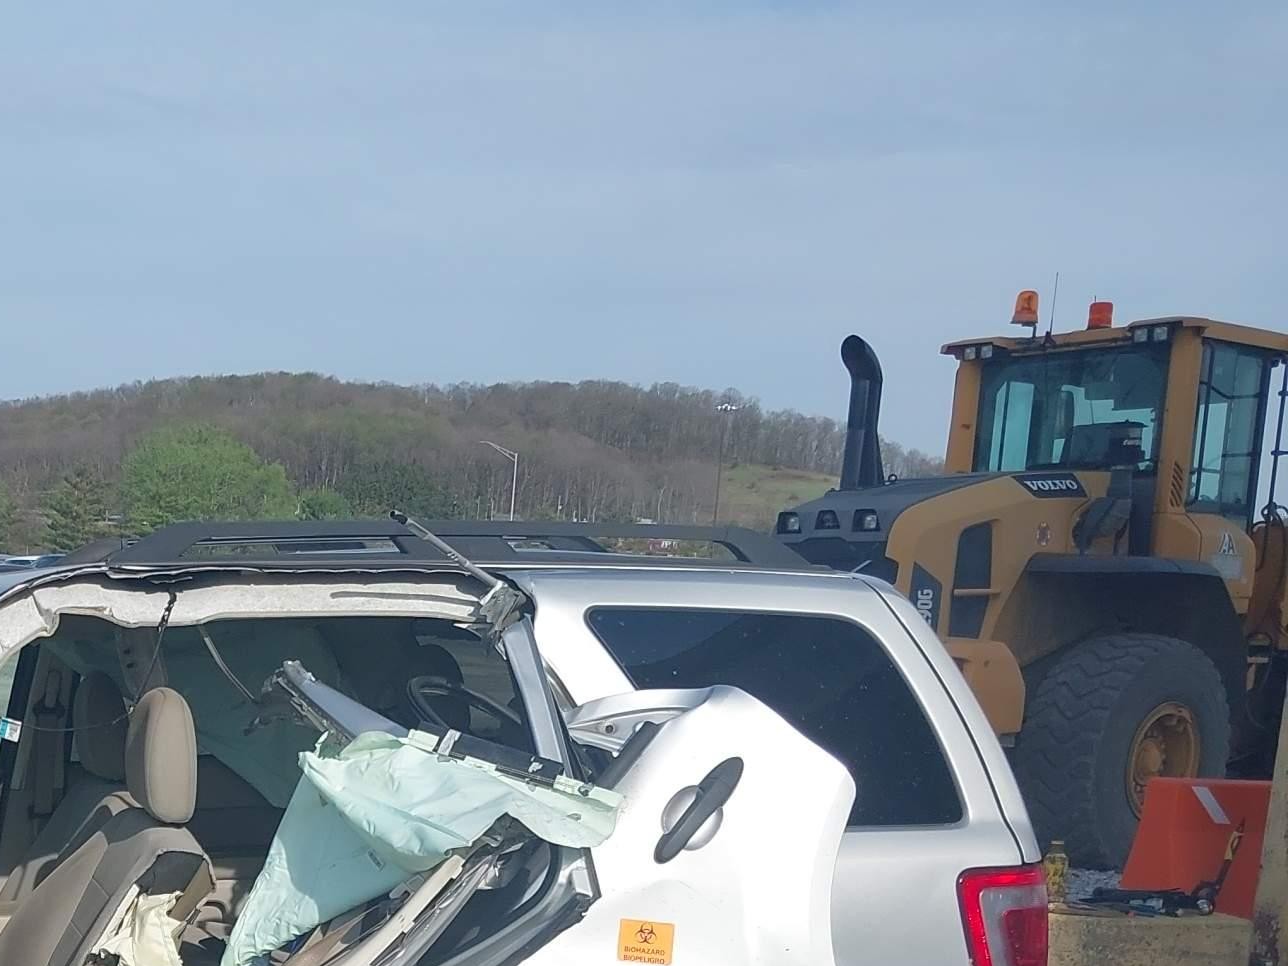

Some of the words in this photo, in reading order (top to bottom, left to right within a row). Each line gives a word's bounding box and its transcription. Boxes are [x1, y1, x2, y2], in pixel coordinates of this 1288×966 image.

[1024, 480, 1078, 490] VOLVO
[624, 945, 665, 955] BIOHAZARD
[623, 954, 665, 964] BIOPELIGRO
